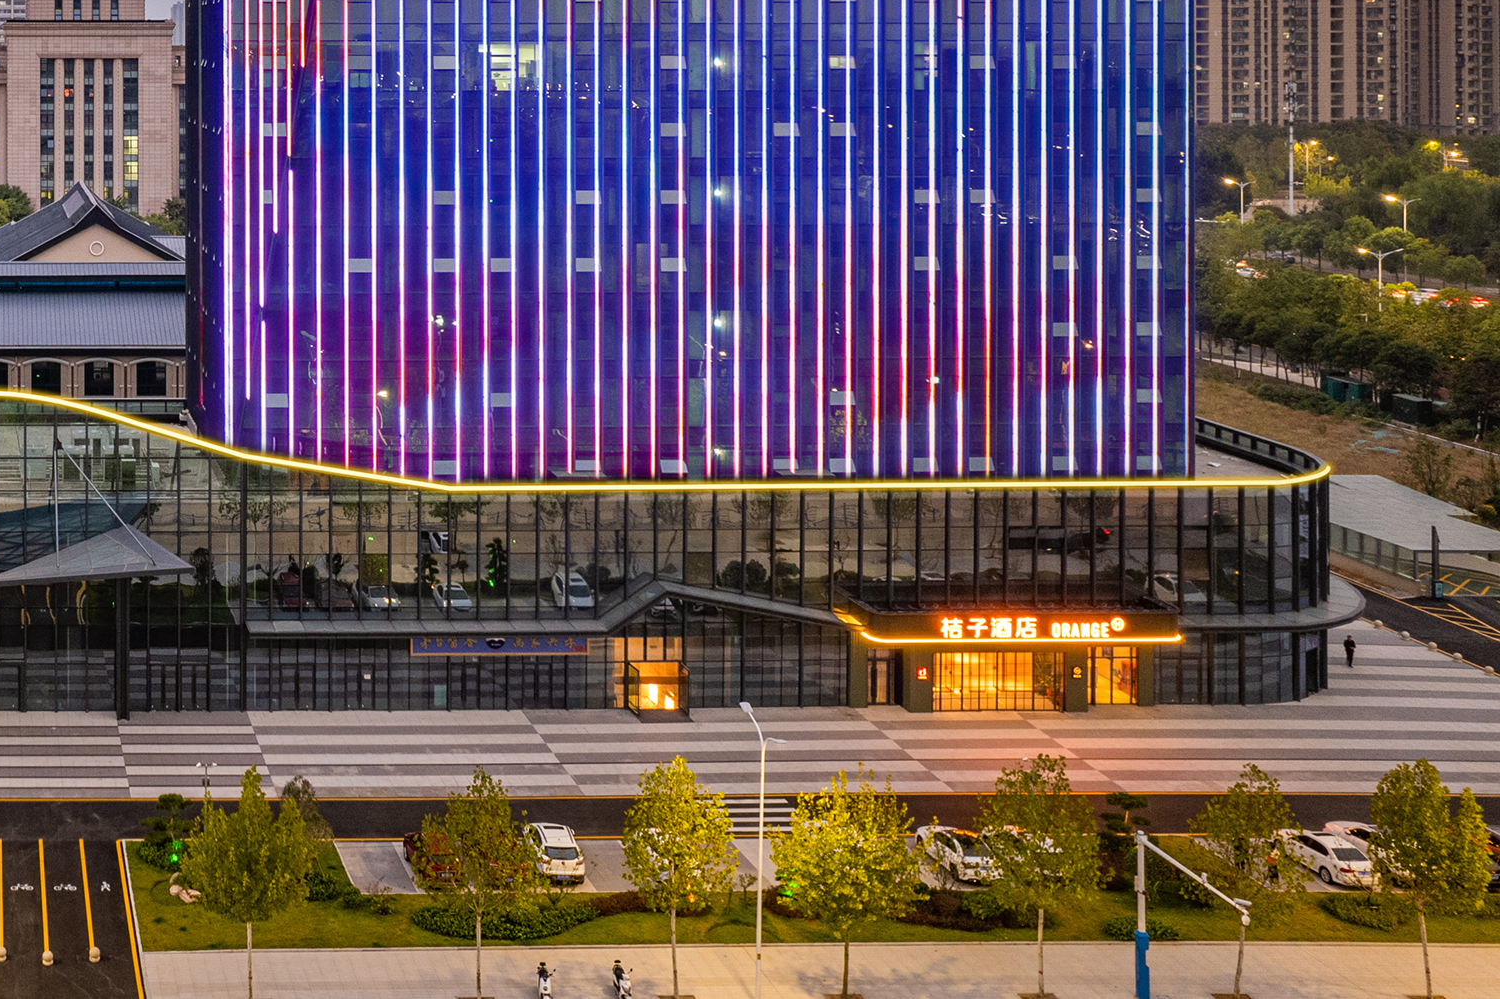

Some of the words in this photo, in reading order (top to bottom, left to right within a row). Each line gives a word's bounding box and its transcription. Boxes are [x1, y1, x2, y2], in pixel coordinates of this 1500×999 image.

[940, 617, 1038, 639] 桔子酒店
[1051, 622, 1110, 638] ORANGE
